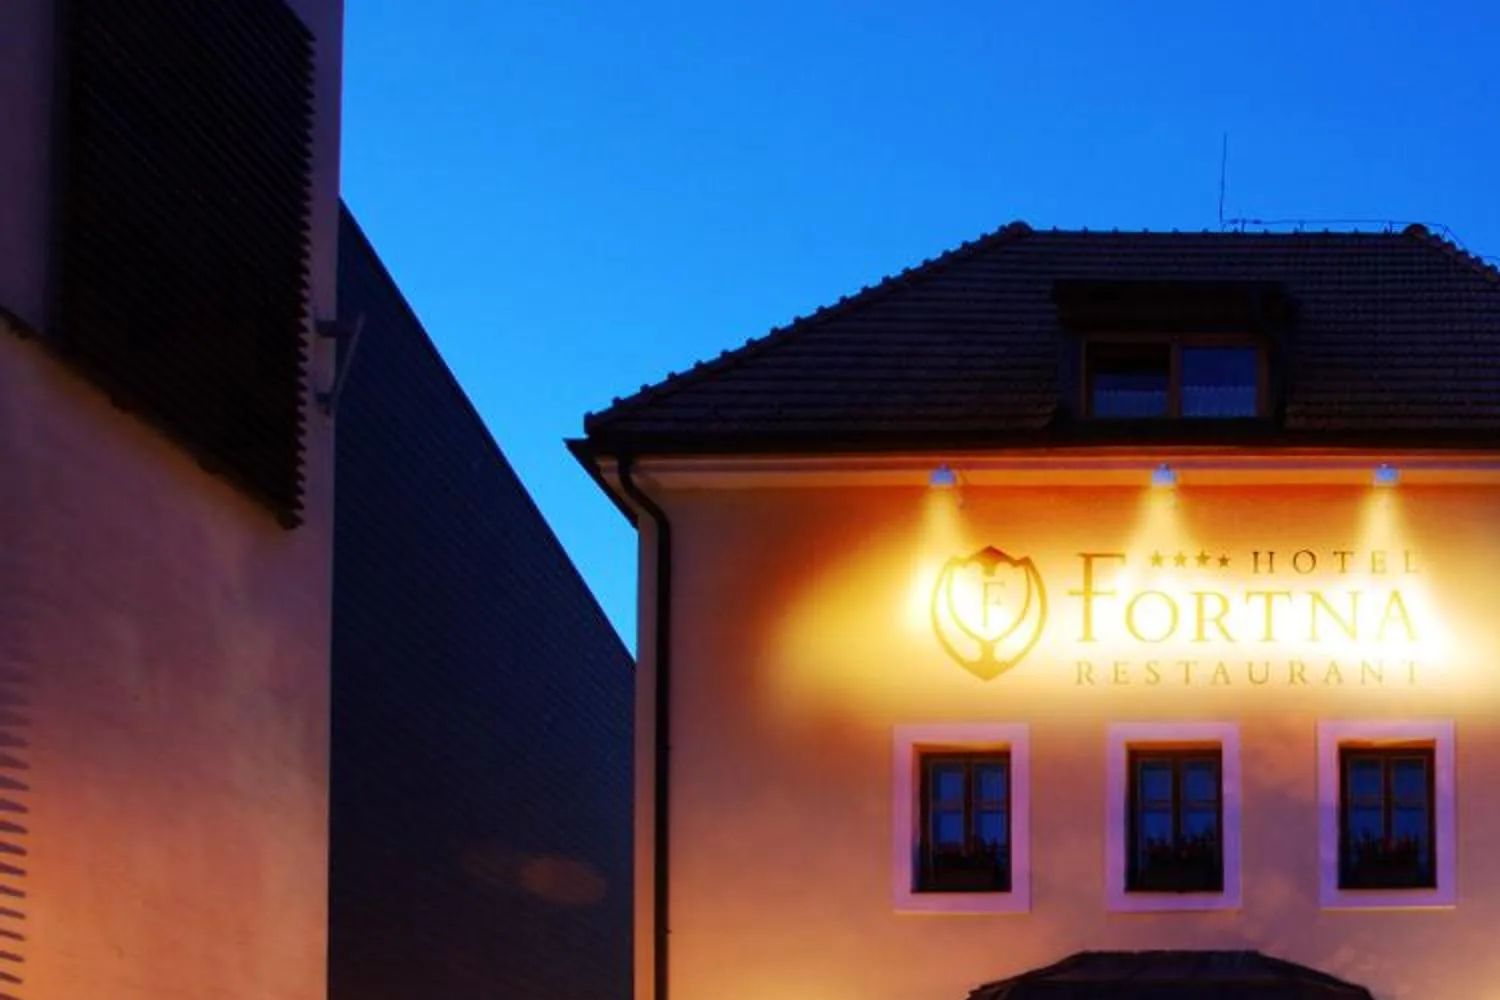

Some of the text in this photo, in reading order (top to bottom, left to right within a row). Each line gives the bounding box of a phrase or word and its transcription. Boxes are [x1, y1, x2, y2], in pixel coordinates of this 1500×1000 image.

[1252, 549, 1420, 574] HOTEL
[1067, 552, 1420, 643] FORTNA
[1075, 659, 1419, 686] RESTAURANT
